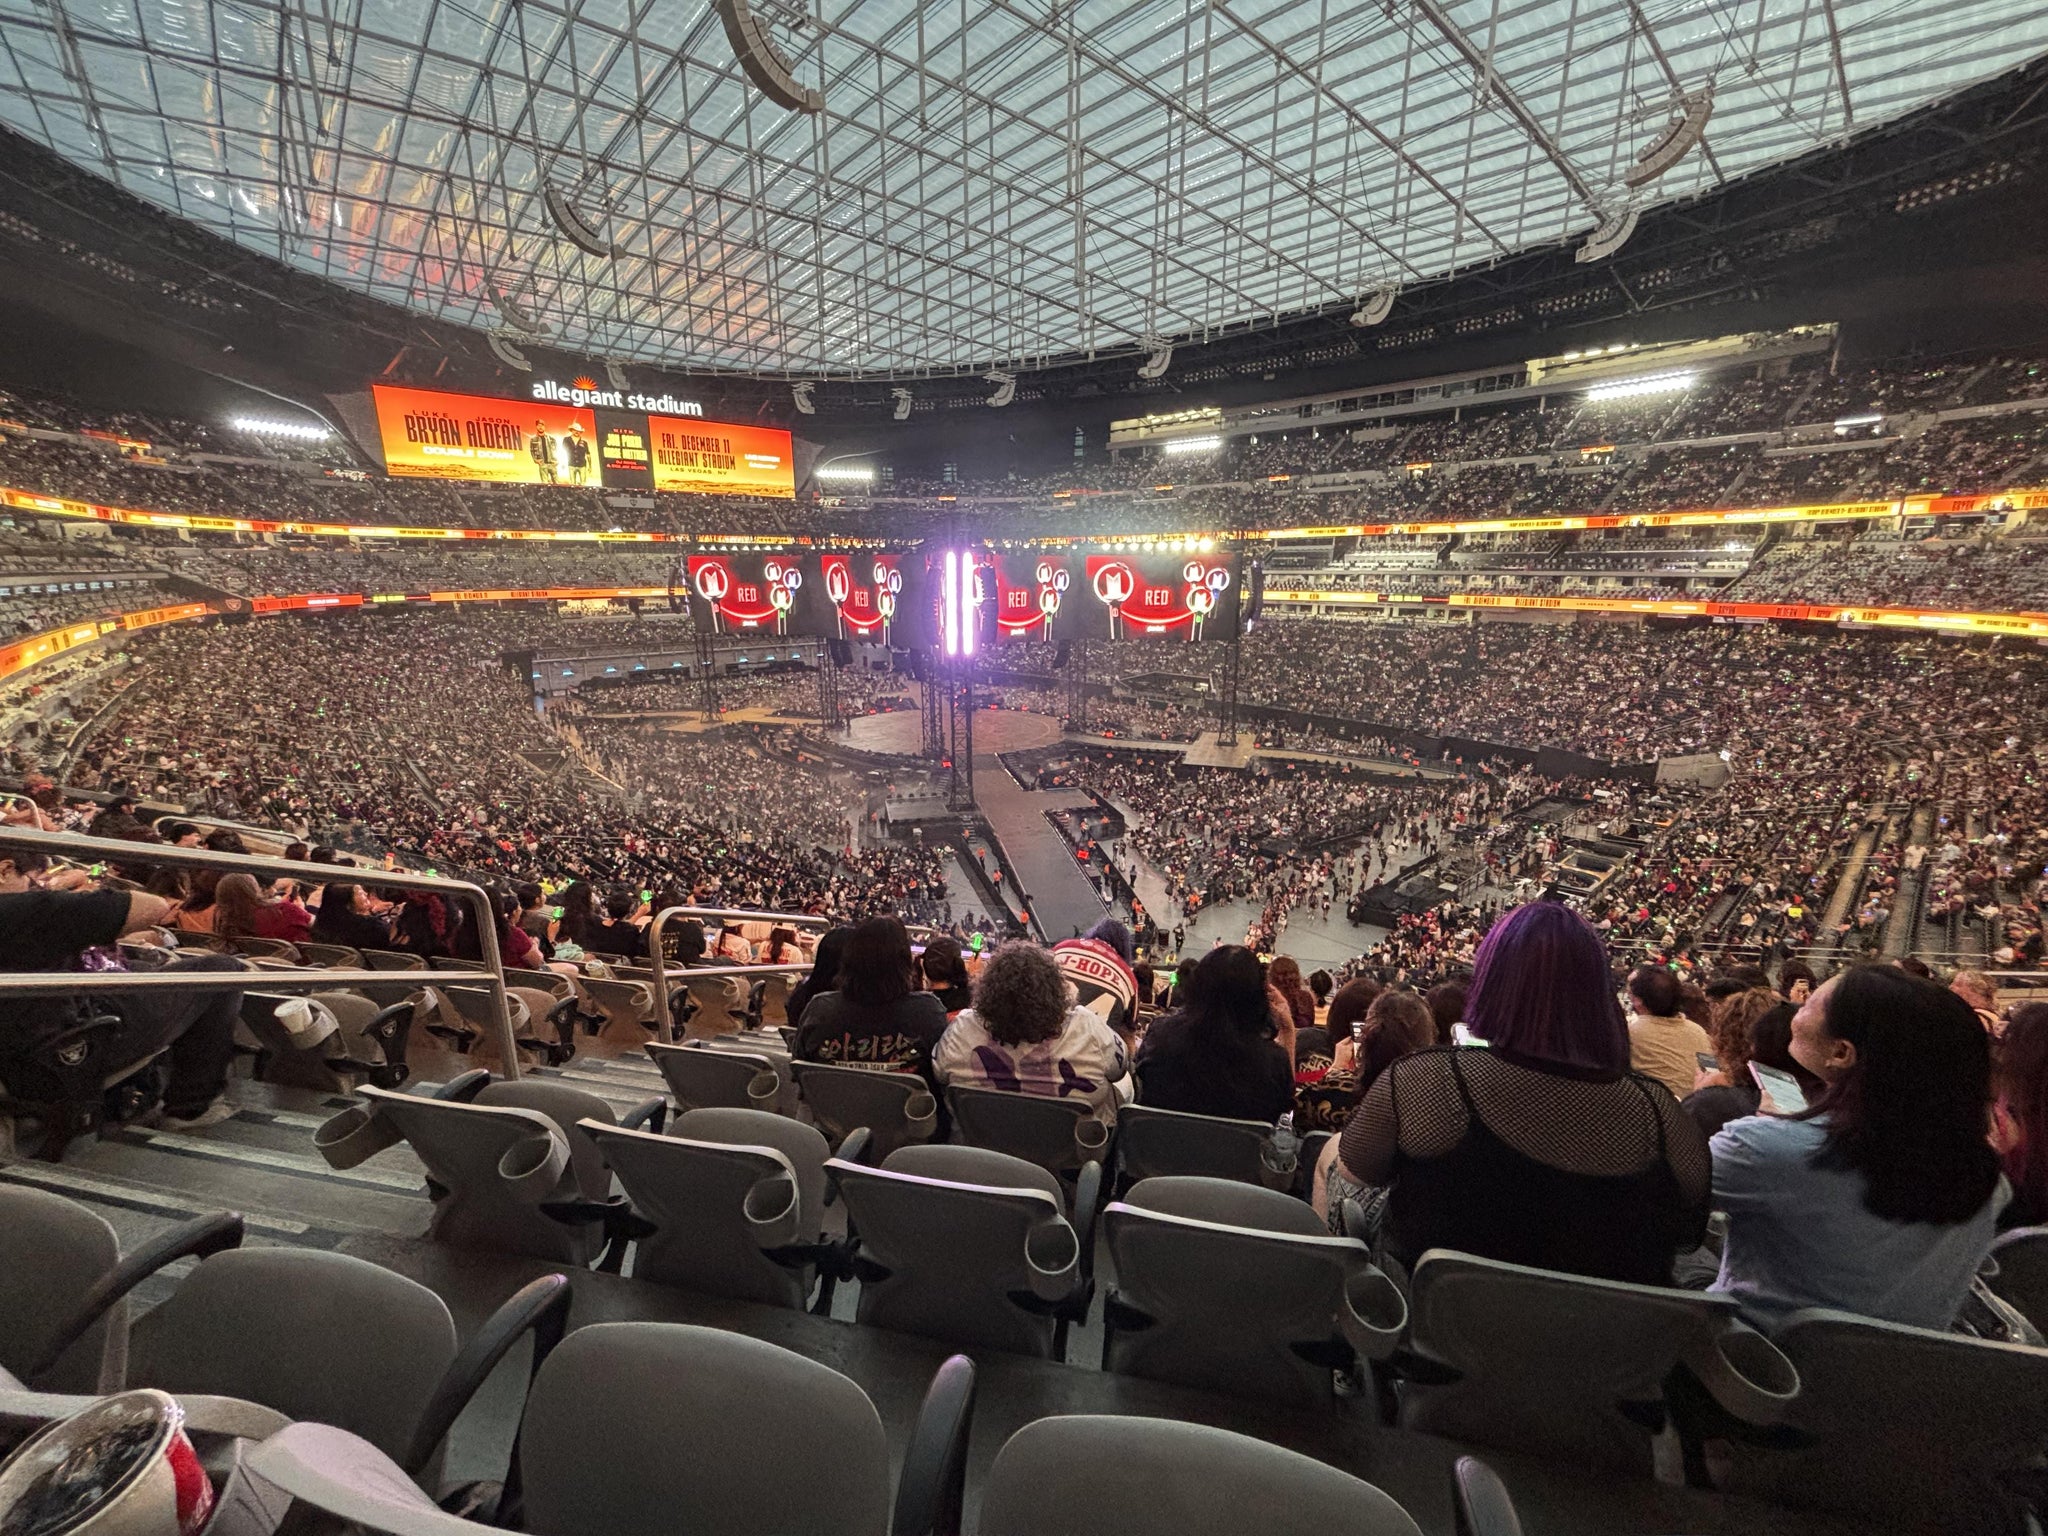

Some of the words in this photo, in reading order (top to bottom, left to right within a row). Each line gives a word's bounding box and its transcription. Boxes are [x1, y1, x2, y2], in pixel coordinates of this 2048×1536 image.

[532, 380, 624, 408] allegiant
[627, 393, 703, 416] stadium
[412, 410, 449, 418] LUKE
[475, 416, 511, 425] JASON
[404, 414, 462, 446] BRYAN
[466, 420, 523, 451] ALDEAN
[661, 432, 679, 449] FRI.
[681, 434, 721, 453] DECEMBER
[723, 439, 731, 454] 11
[657, 449, 699, 468] ALLEGIANT
[702, 453, 737, 471] STADIUM
[737, 587, 757, 602] RED
[855, 591, 869, 607] RED
[1008, 592, 1027, 608] RED
[1145, 589, 1169, 606] RED
[1062, 955, 1122, 986] J-HOPE
